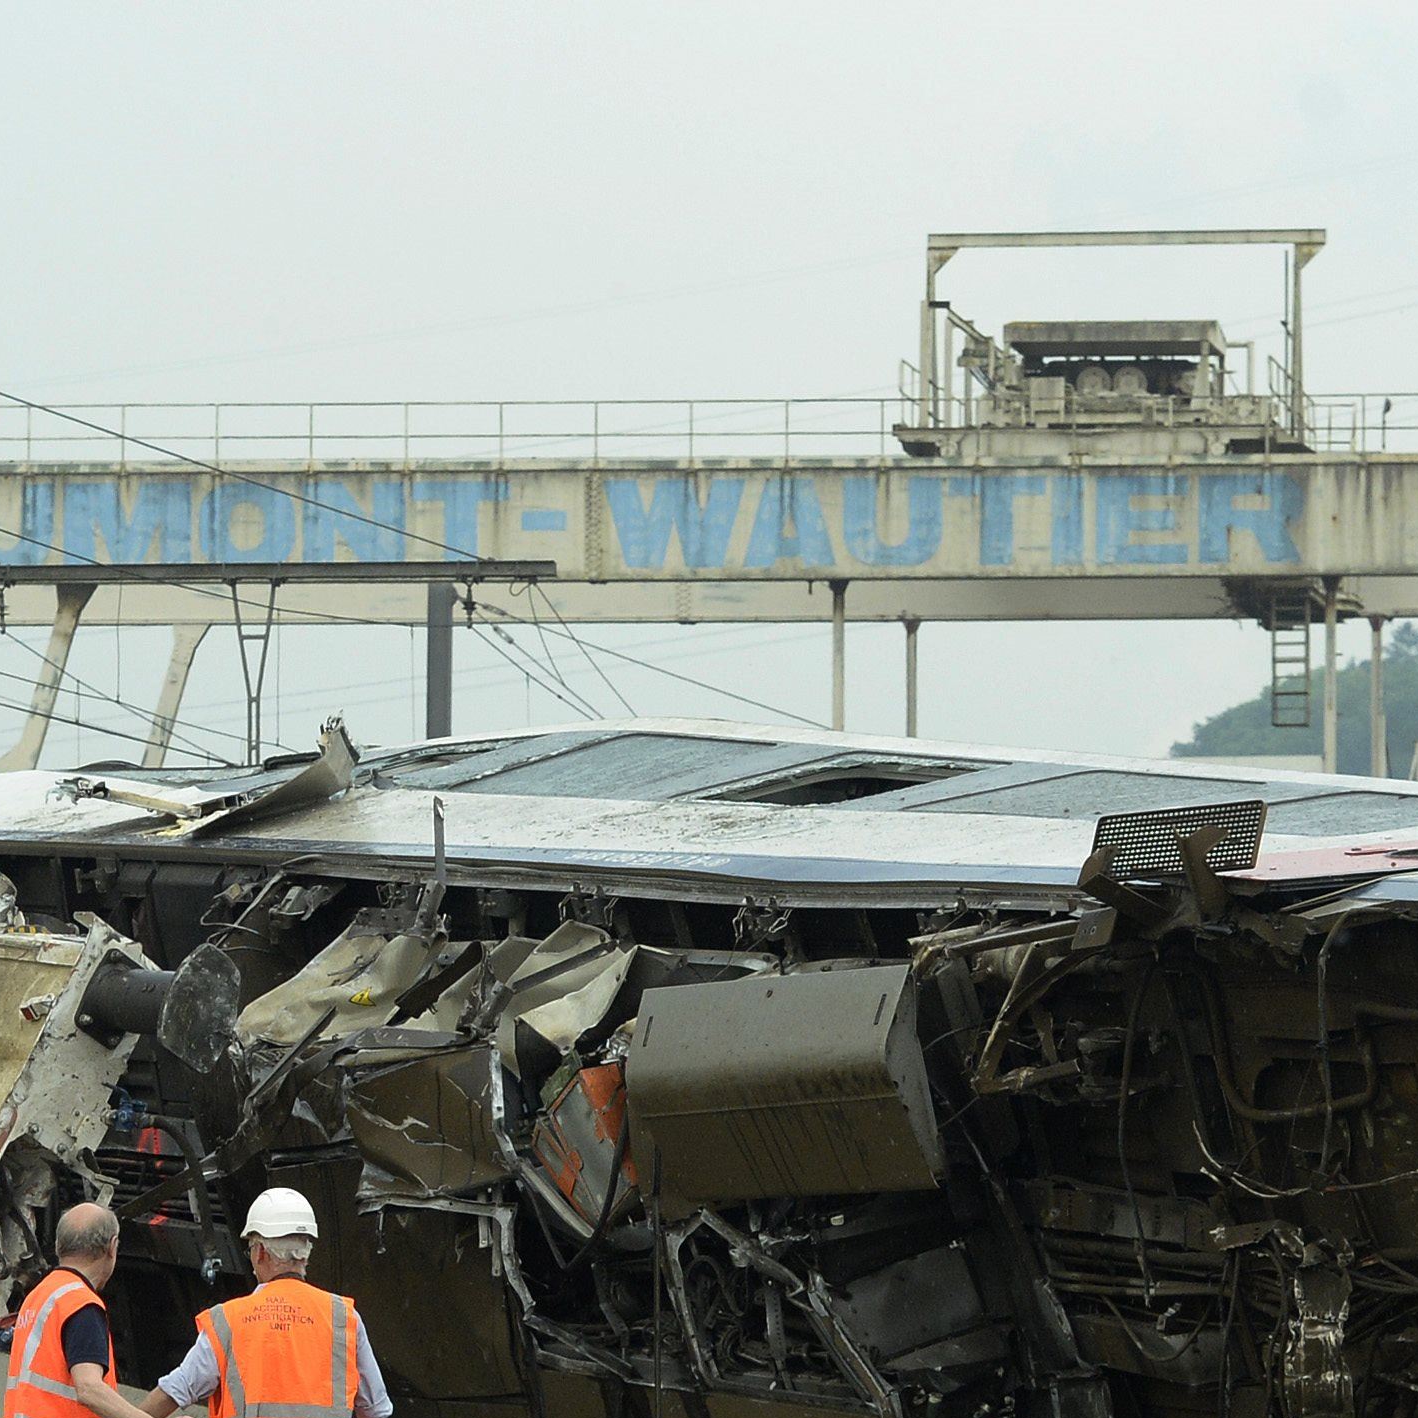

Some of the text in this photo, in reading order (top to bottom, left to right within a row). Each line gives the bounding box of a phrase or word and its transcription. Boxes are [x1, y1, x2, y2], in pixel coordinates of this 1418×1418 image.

[265, 1296, 288, 1304] RAIL
[253, 1304, 302, 1313] ACCIDENT
[242, 1312, 314, 1324] INVESTIGATION
[269, 1322, 291, 1331] UNIT
